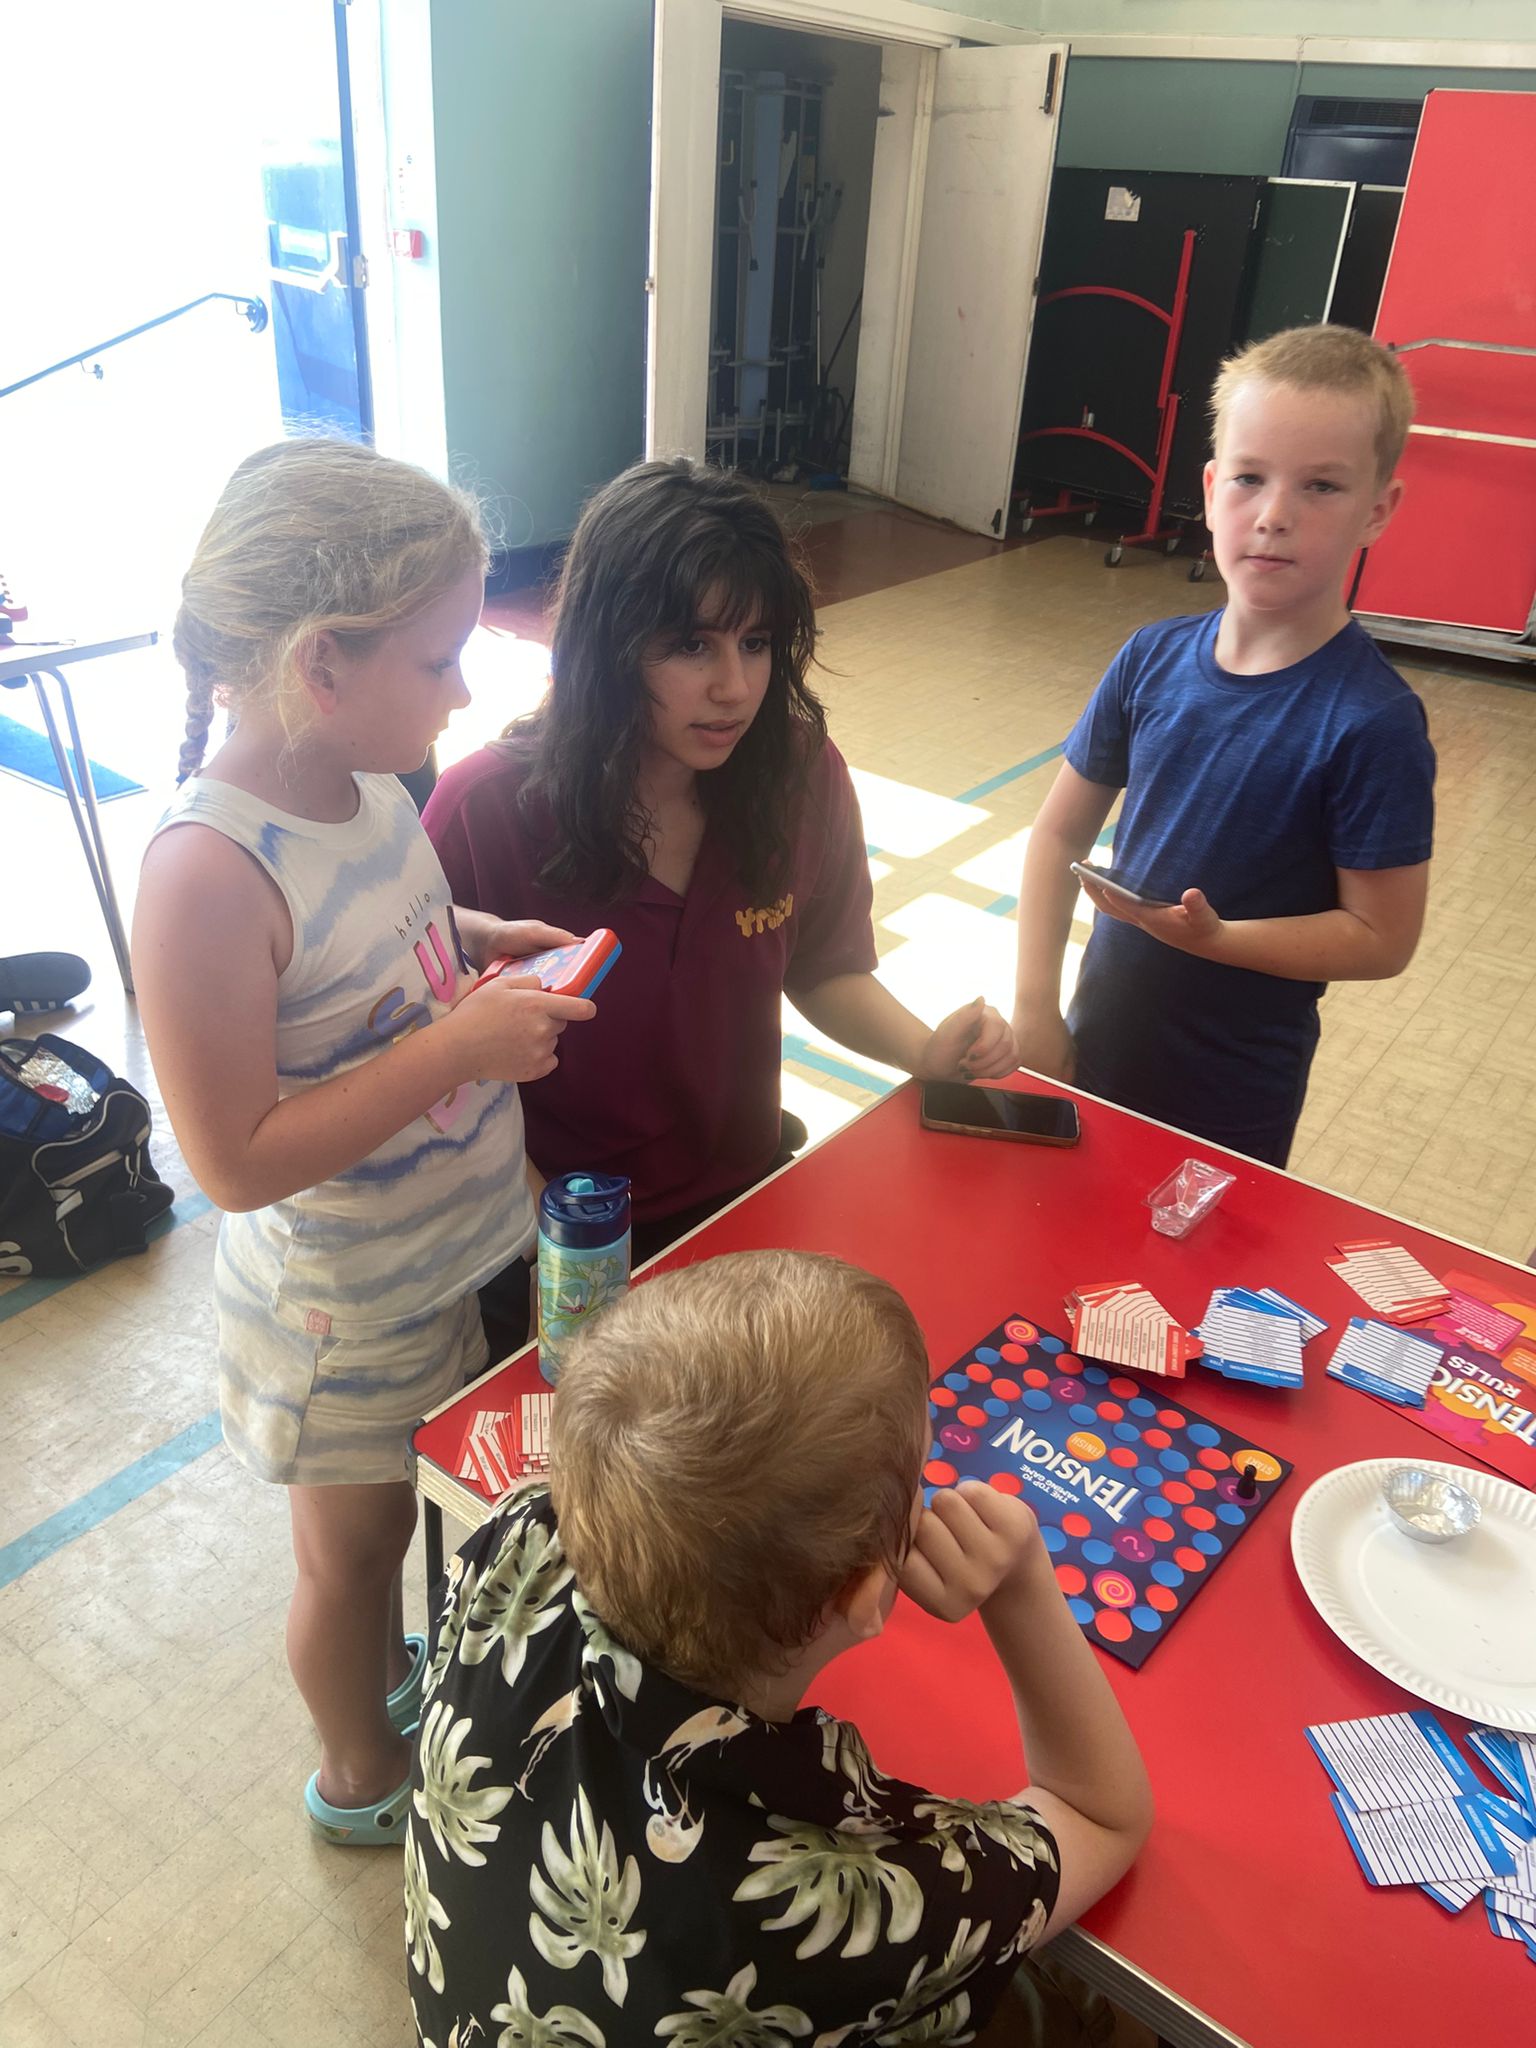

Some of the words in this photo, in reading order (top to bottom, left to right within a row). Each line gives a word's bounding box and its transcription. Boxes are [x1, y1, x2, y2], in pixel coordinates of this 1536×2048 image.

[394, 891, 431, 940] hello
[1448, 1355, 1521, 1399] RULES
[1427, 1367, 1536, 1445] TENSIO
[1069, 1434, 1102, 1459] FINISH
[991, 1415, 1140, 1524] TENSION
[1019, 1462, 1046, 1483] GAME
[1021, 1471, 1034, 1483] 10
[1244, 1455, 1274, 1475] START
[1032, 1478, 1051, 1493] TOP
[1044, 1477, 1080, 1504] NAMING
[1050, 1489, 1069, 1505] THE
